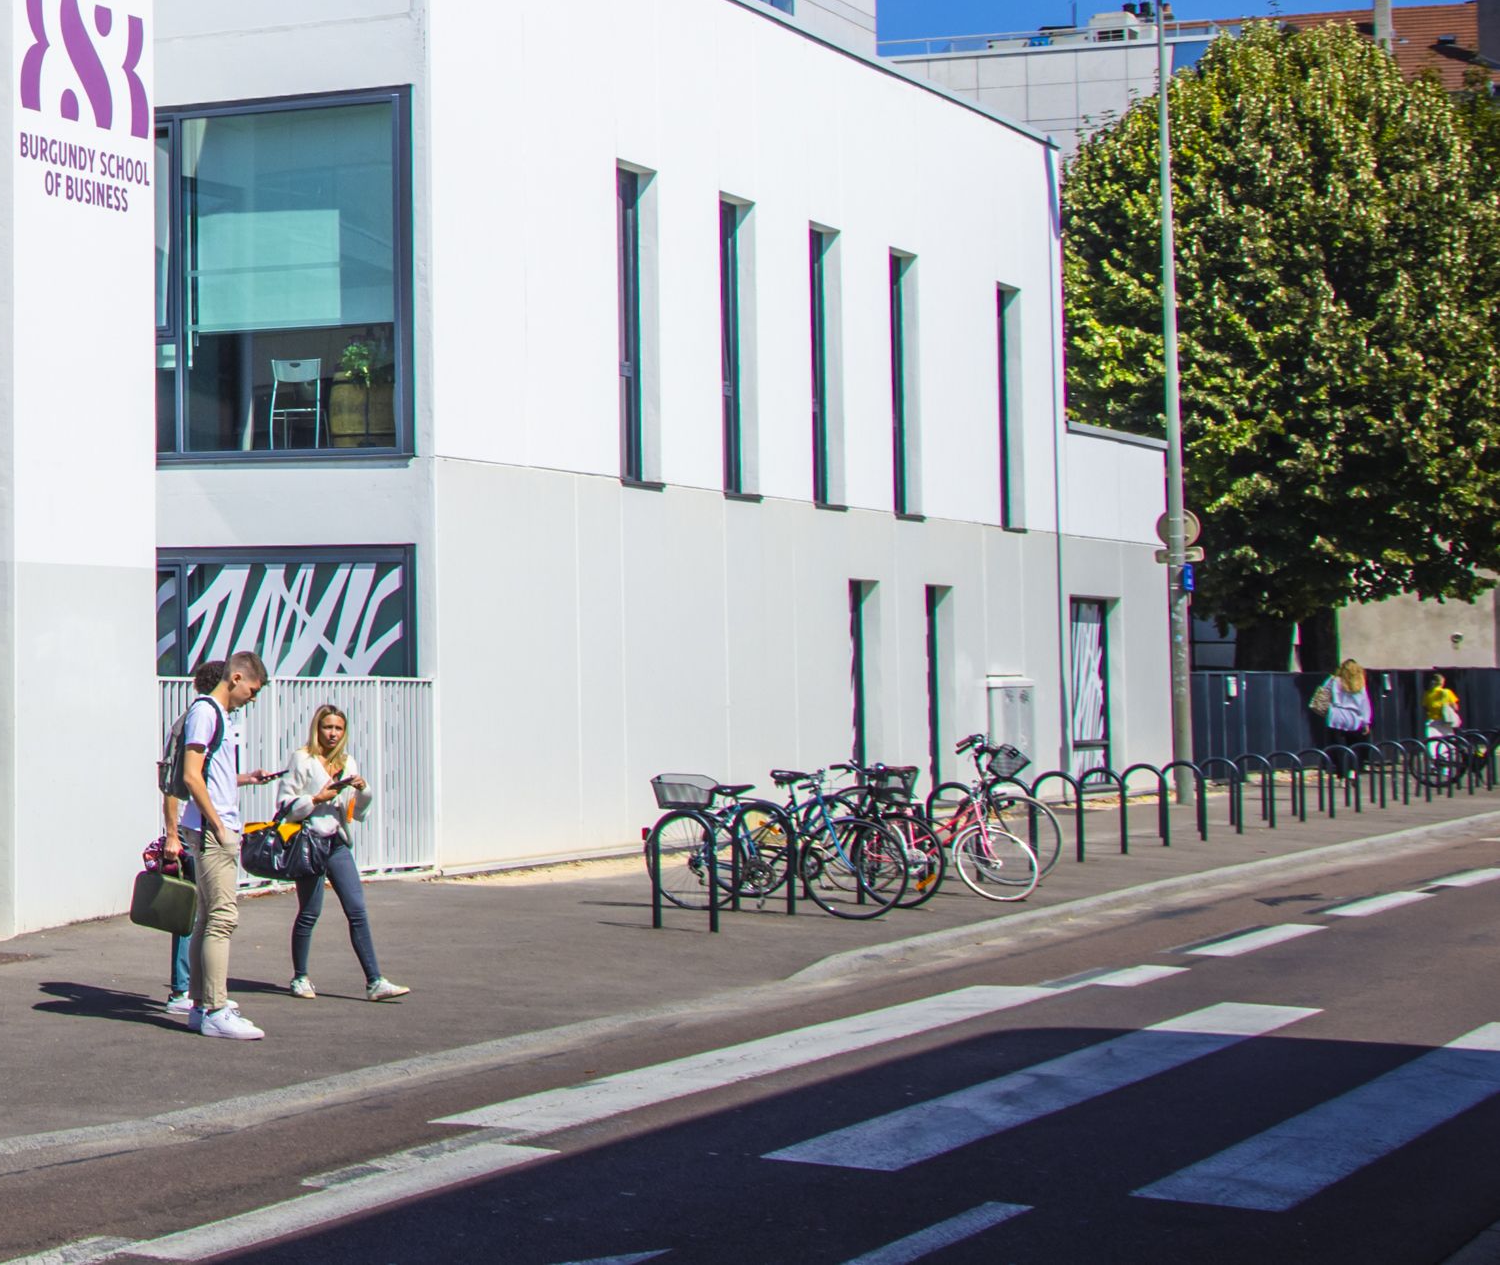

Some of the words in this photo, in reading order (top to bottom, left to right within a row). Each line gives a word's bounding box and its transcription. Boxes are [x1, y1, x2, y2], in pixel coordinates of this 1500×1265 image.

[19, 131, 96, 174] BURGUNDY
[99, 151, 150, 187] SCHOOL
[44, 170, 62, 197] OF
[65, 175, 129, 213] BUSINESS
